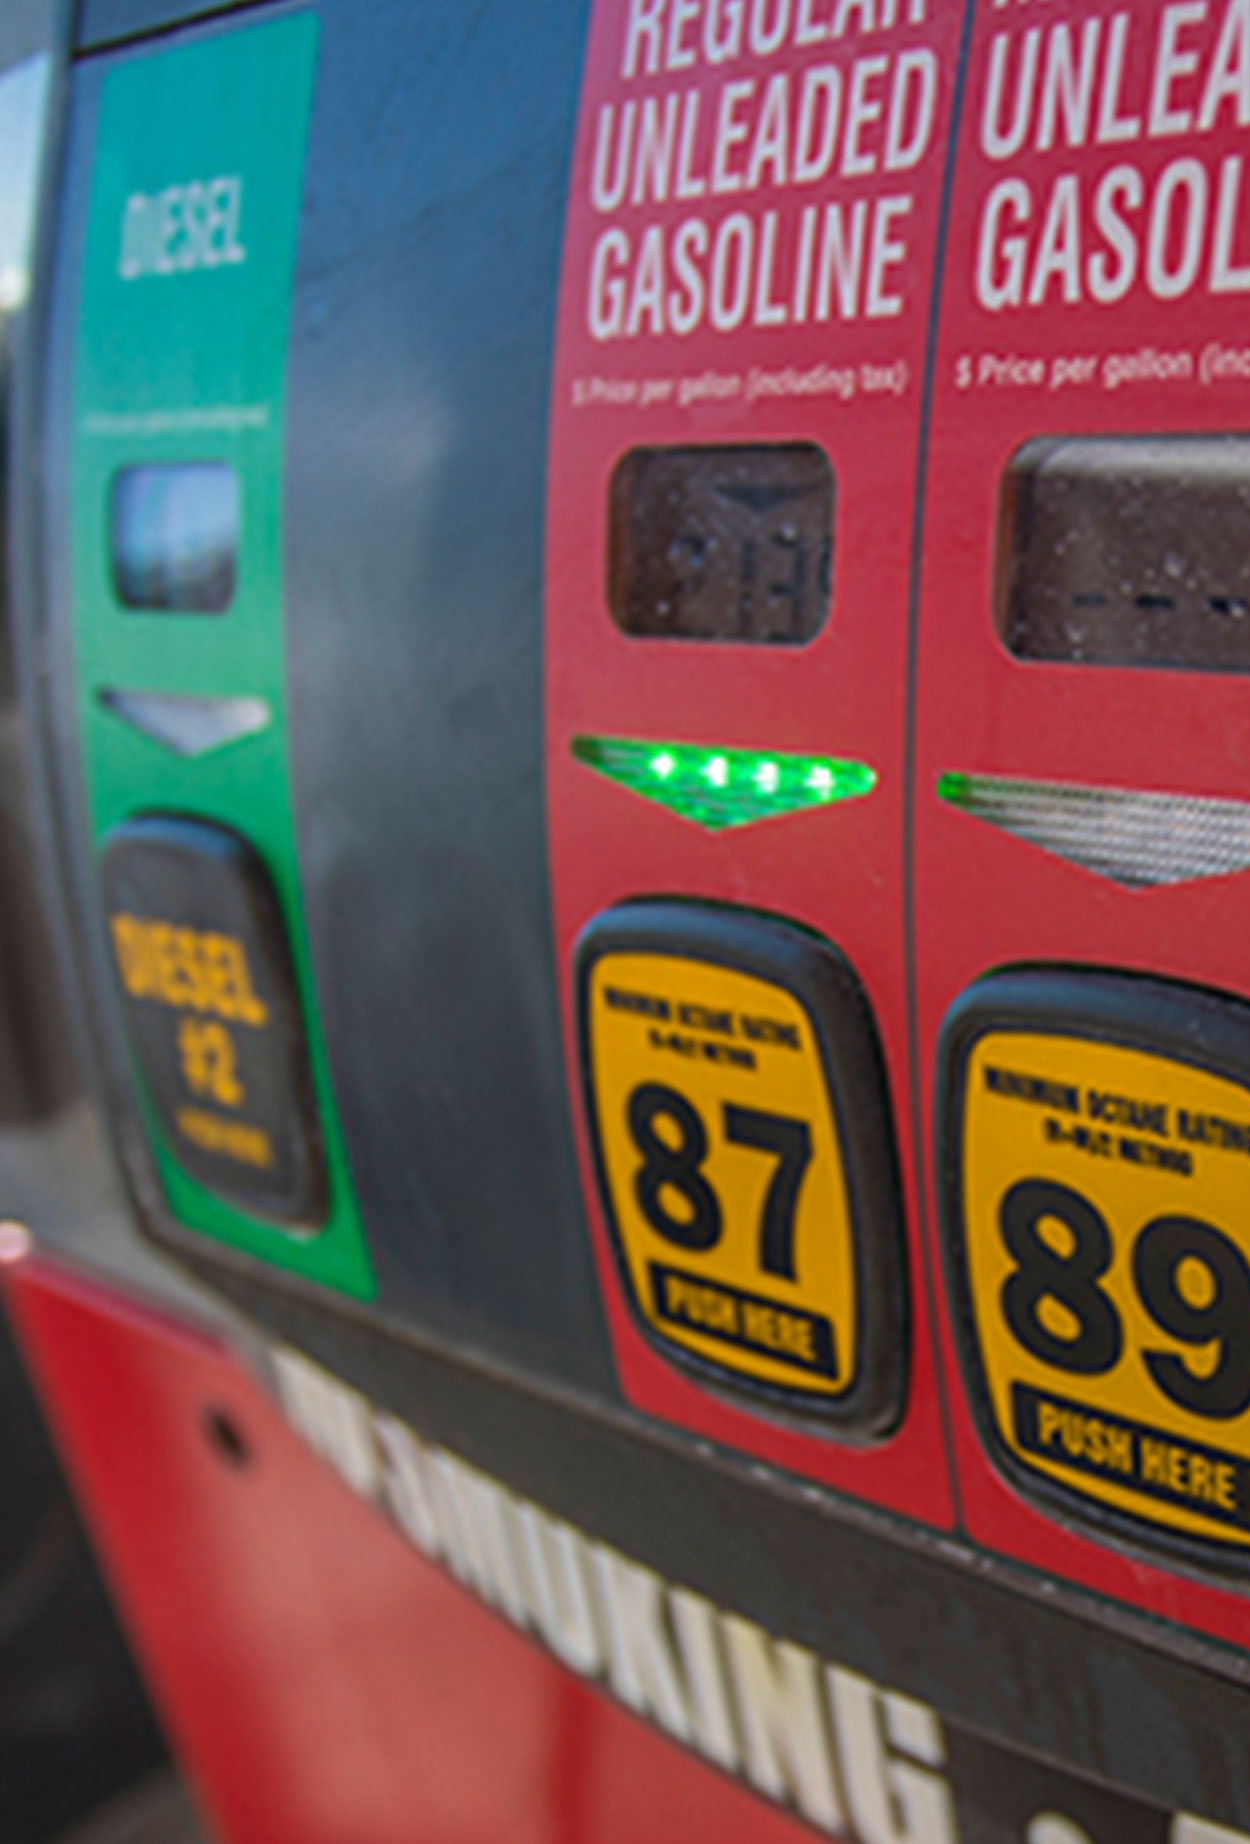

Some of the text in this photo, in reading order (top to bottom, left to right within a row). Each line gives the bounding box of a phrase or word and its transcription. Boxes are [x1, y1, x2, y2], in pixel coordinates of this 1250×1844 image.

[622, 0, 925, 78] REGU
[592, 47, 937, 211] UNLEADED
[117, 175, 246, 281] DIESEL
[588, 195, 912, 341] GASOLINE
[954, 355, 971, 389] $
[977, 353, 1045, 386] Price
[1049, 356, 1098, 391] per
[1103, 346, 1193, 390] gallon
[109, 911, 269, 1030] DIESEL
[984, 1065, 1079, 1116] MINIMUM
[1087, 1088, 1171, 1138] OCTANE
[624, 1080, 815, 1285] 87
[665, 1275, 817, 1364] PUSH HERE
[1038, 1406, 1238, 1511] PUSH HERE
